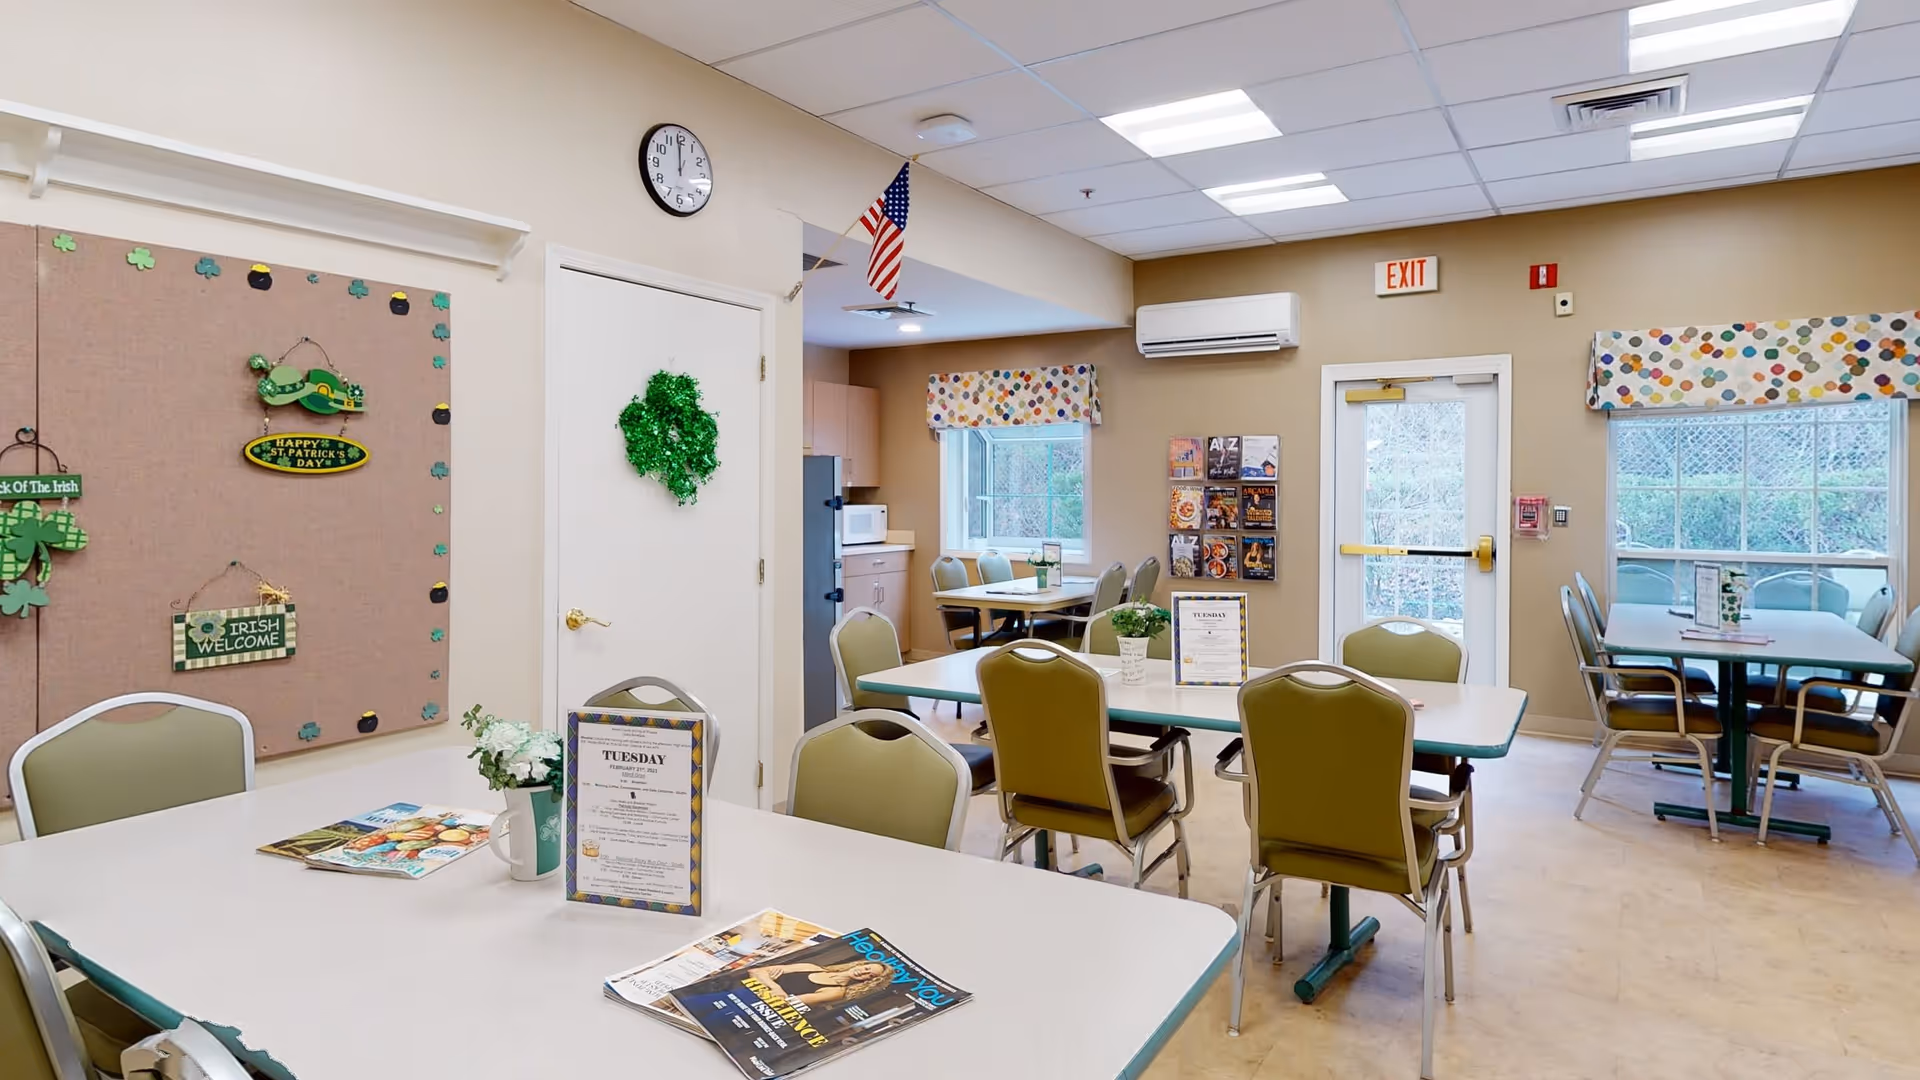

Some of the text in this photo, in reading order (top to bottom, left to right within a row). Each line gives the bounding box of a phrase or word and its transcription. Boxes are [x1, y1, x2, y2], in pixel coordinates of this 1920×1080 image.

[665, 134, 672, 146] 11
[656, 143, 666, 155] 10
[652, 157, 659, 167] 9
[696, 157, 702, 167] 2
[656, 173, 664, 184] 8
[665, 186, 672, 196] 7
[676, 194, 683, 205] 6
[688, 193, 695, 204] 5
[1387, 259, 1427, 290] EXIT
[276, 439, 320, 448] HAPPY
[288, 449, 345, 459] PATRICK'S
[297, 459, 324, 467] DAY
[13, 480, 28, 493] Of
[29, 480, 51, 493] The
[52, 480, 79, 493] Irish
[230, 618, 279, 636] IRISH
[197, 632, 279, 654] WELCOME
[602, 750, 666, 765] TUESDAY
[610, 764, 635, 772] FEBRUARY
[842, 931, 918, 984] Healthy
[910, 978, 955, 1006] You
[785, 993, 812, 1015] THE
[740, 977, 829, 1048] RESILIENCE
[750, 1000, 787, 1030] ISSUE
